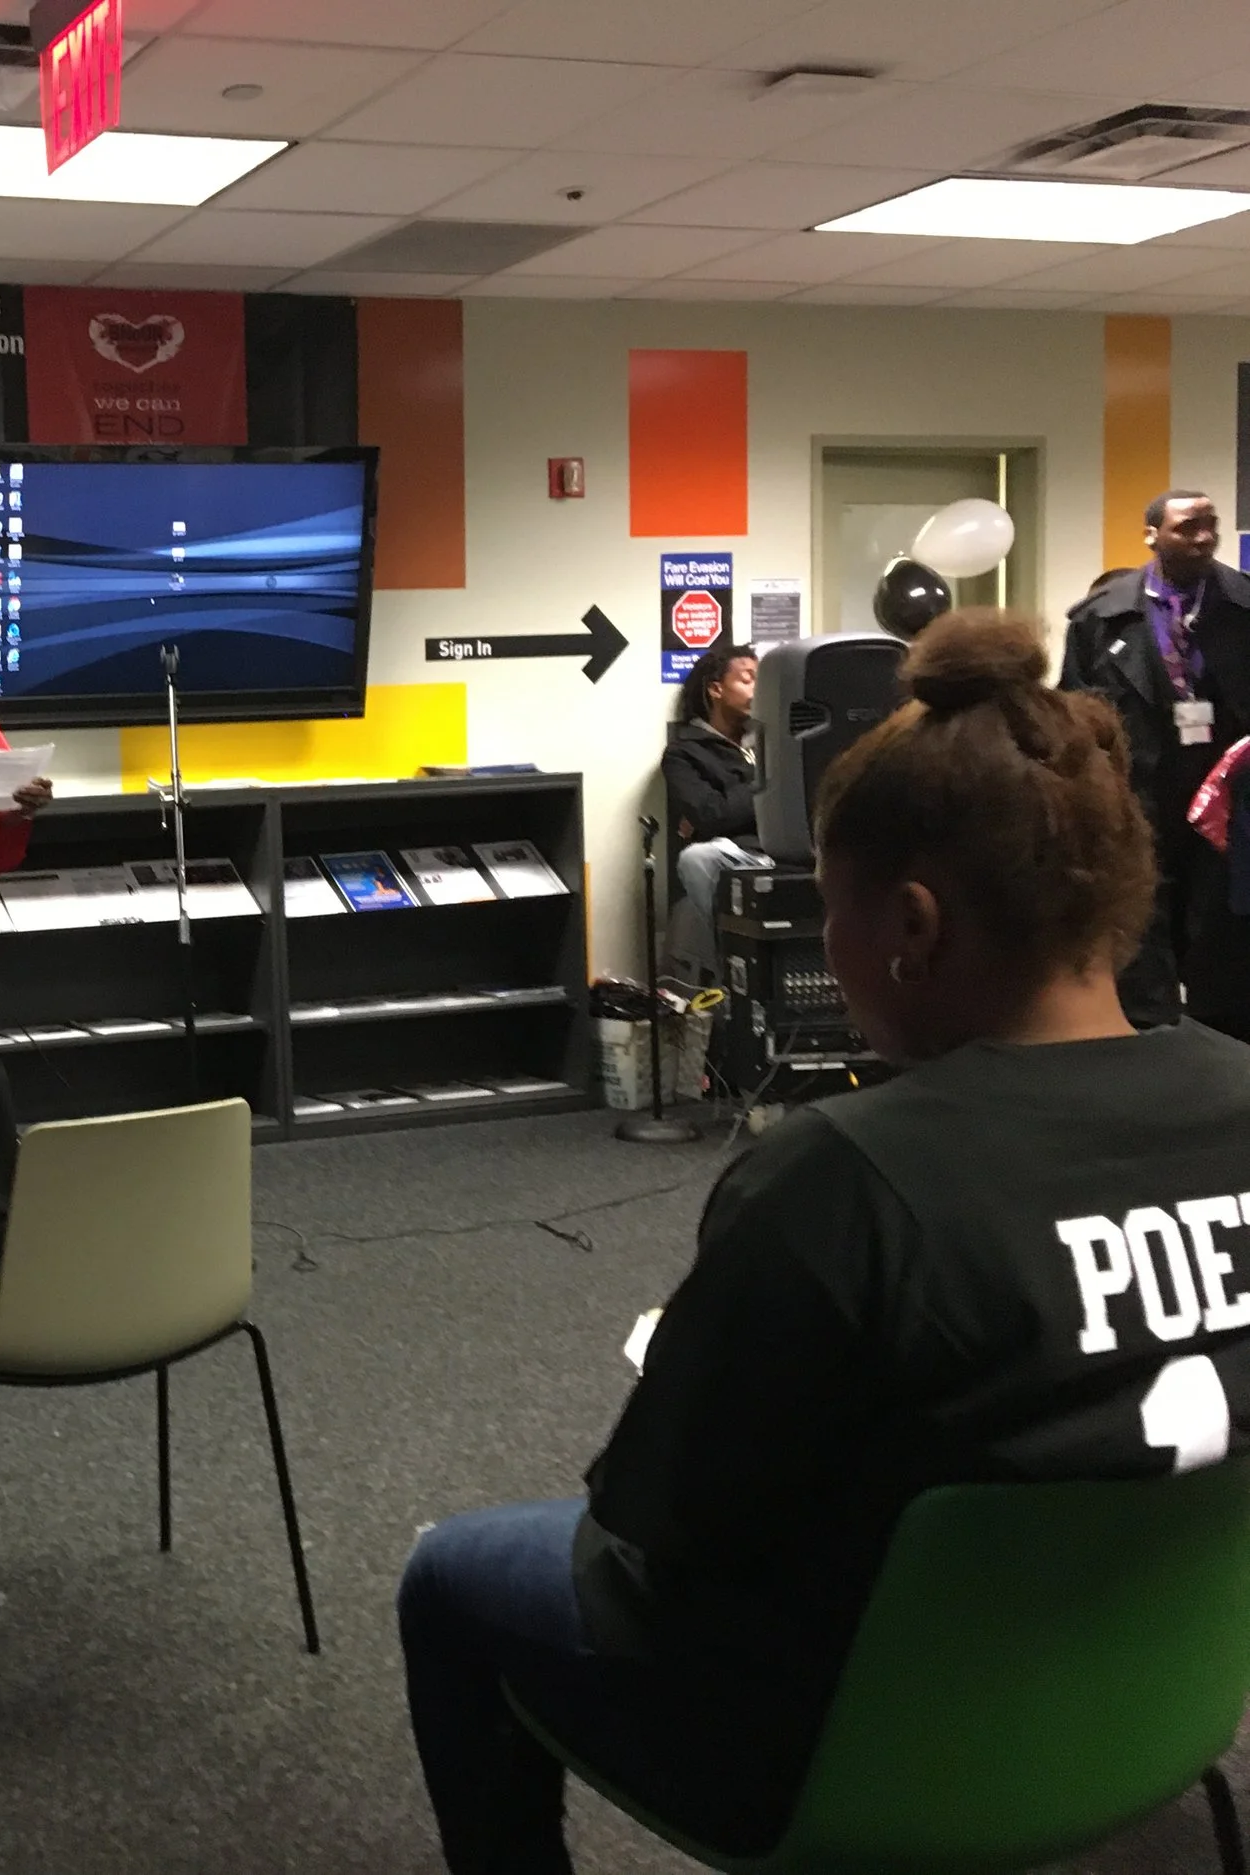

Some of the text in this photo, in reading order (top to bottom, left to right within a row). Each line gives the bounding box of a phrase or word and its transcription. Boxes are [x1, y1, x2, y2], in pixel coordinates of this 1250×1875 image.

[94, 397, 182, 411] we can
[94, 413, 185, 436] END
[689, 560, 730, 574] Evasion
[663, 573, 730, 587] Will Cost You
[438, 639, 493, 660] Sign In
[1055, 1191, 1250, 1354] POE
